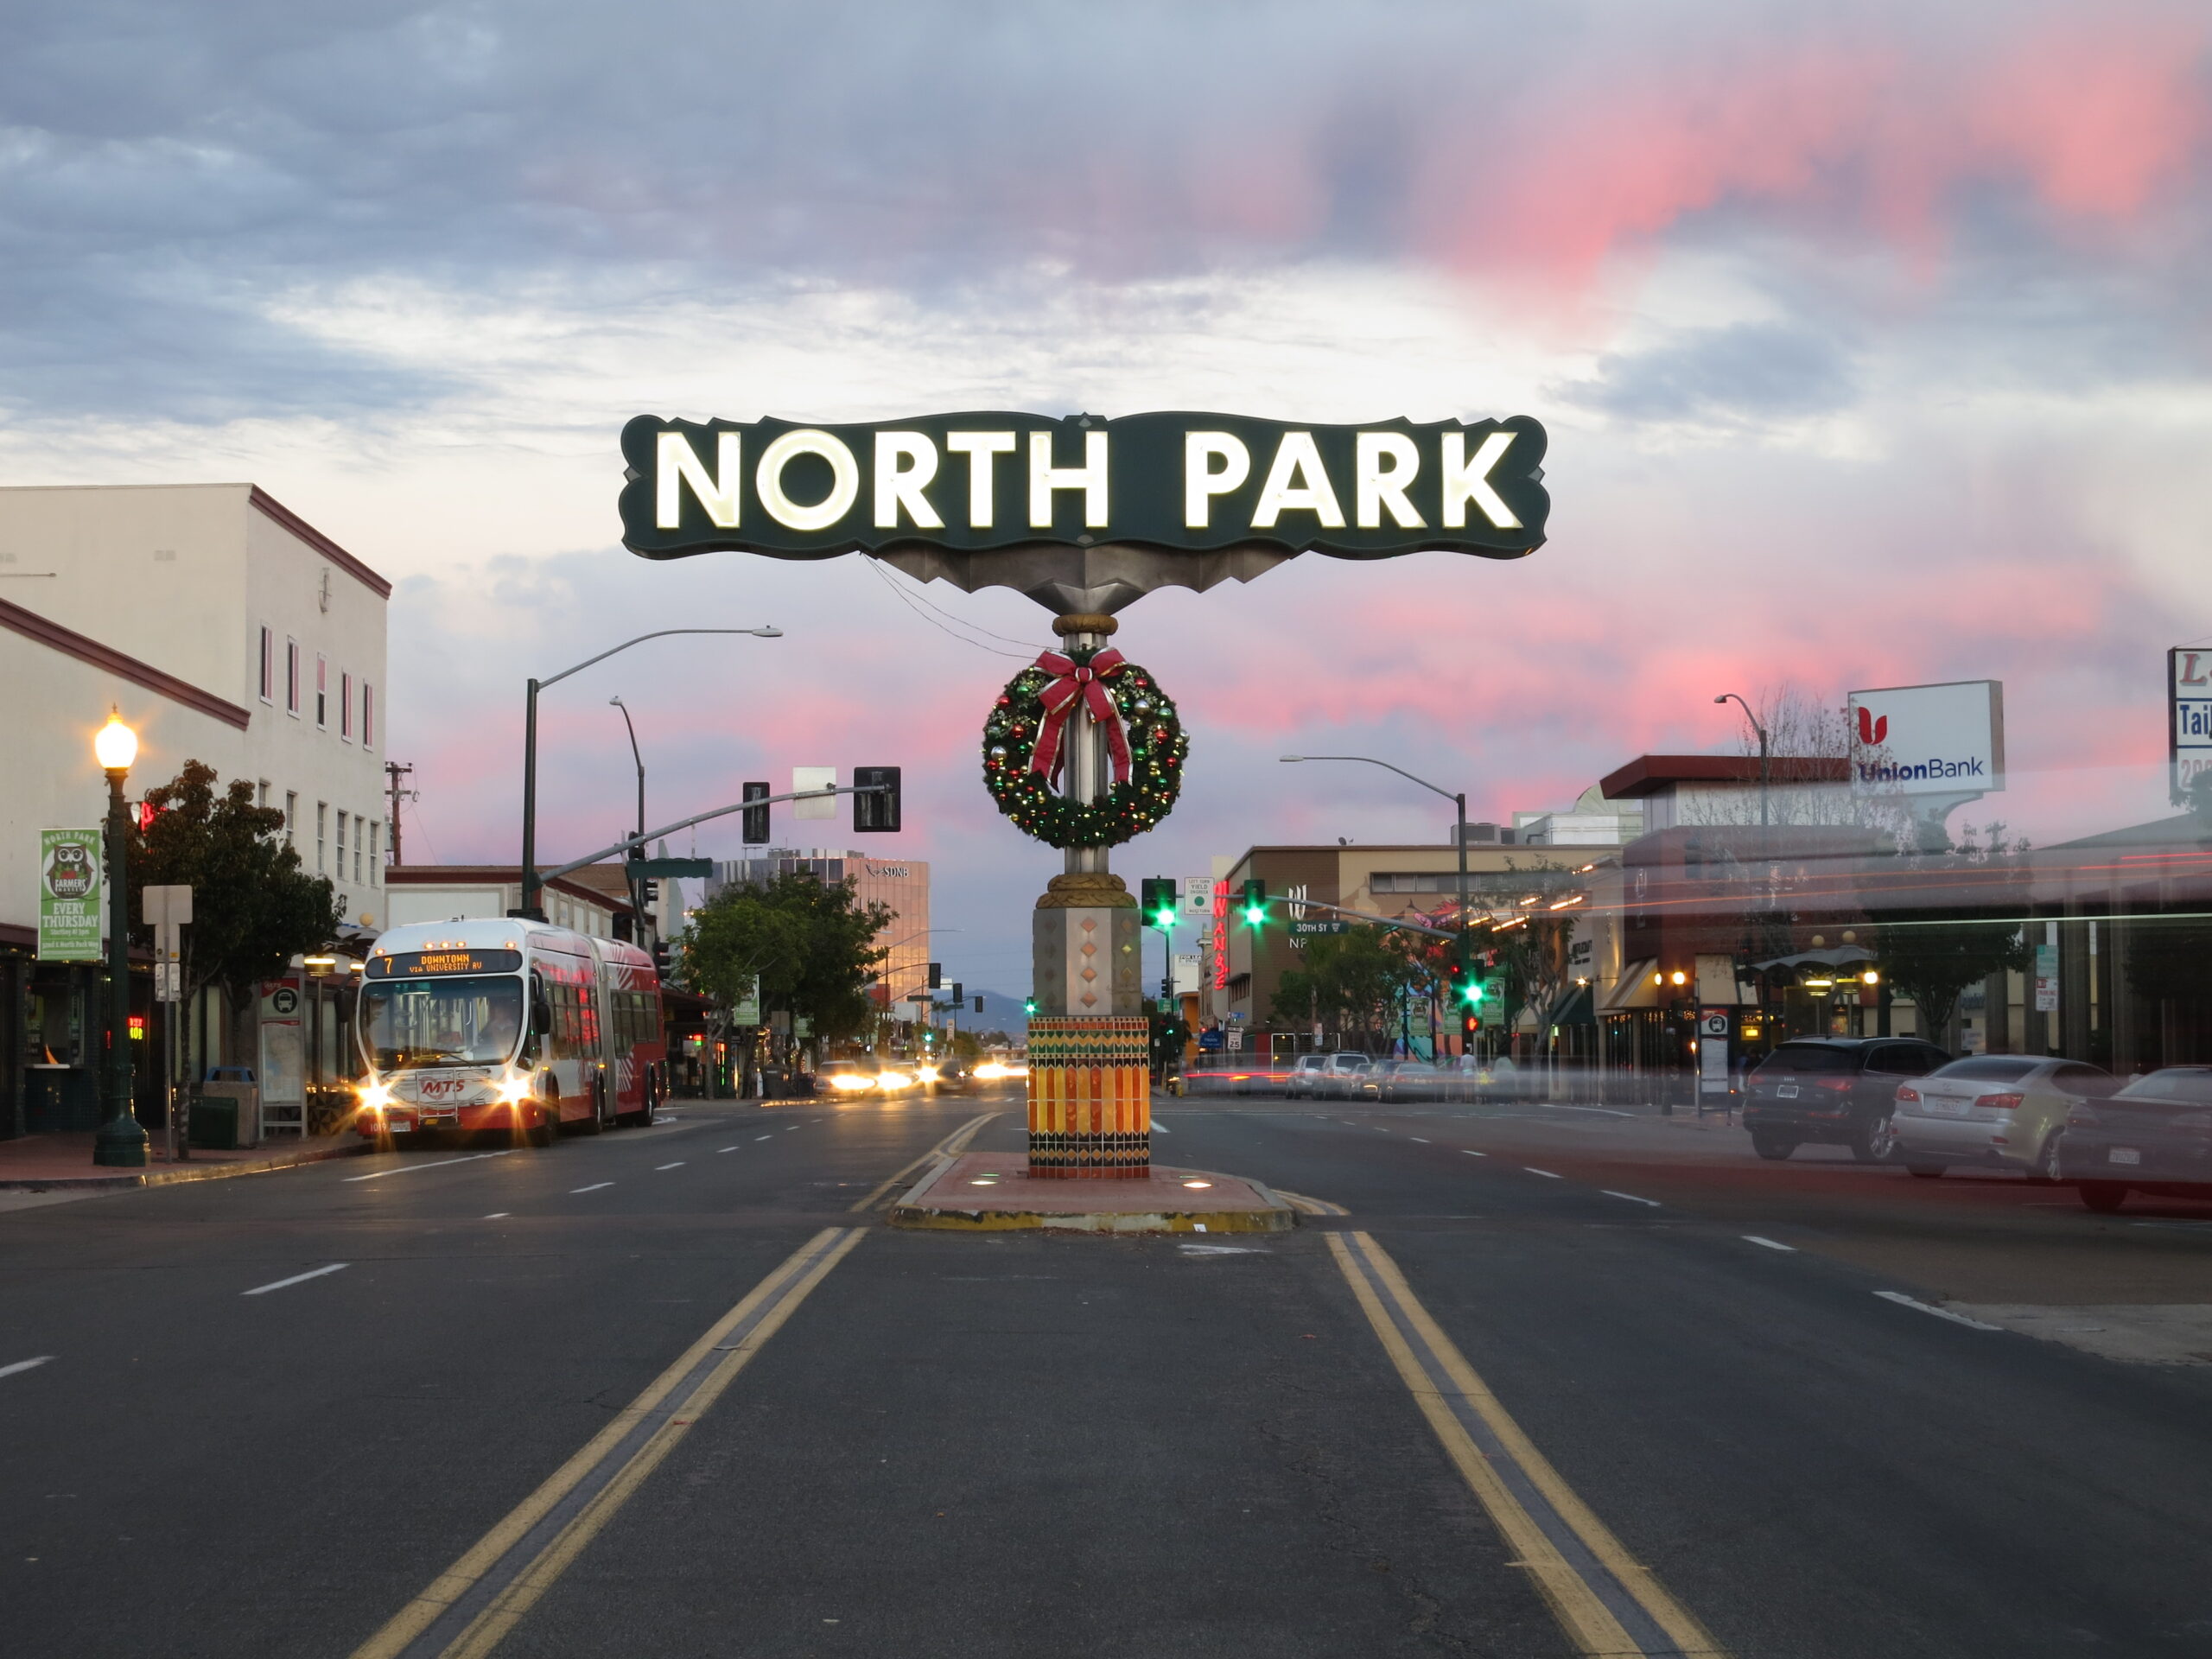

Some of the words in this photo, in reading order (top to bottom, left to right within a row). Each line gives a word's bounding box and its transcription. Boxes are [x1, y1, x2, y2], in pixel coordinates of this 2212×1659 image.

[657, 429, 1109, 531] NORTH
[1185, 430, 1524, 529] PARK
[2179, 653, 2212, 686] L
[43, 831, 71, 846] NORTH
[74, 831, 96, 845] PARK
[883, 867, 909, 878] SDNB
[54, 902, 85, 915] EVERY
[42, 915, 99, 928] THURSDAY
[1296, 923, 1317, 932] 30TH
[1318, 923, 1328, 932] ST
[384, 957, 393, 974] 7
[421, 954, 470, 965] DOWNTOWN
[426, 963, 469, 972] UNIVERSITY
[422, 1079, 465, 1094] MTS
